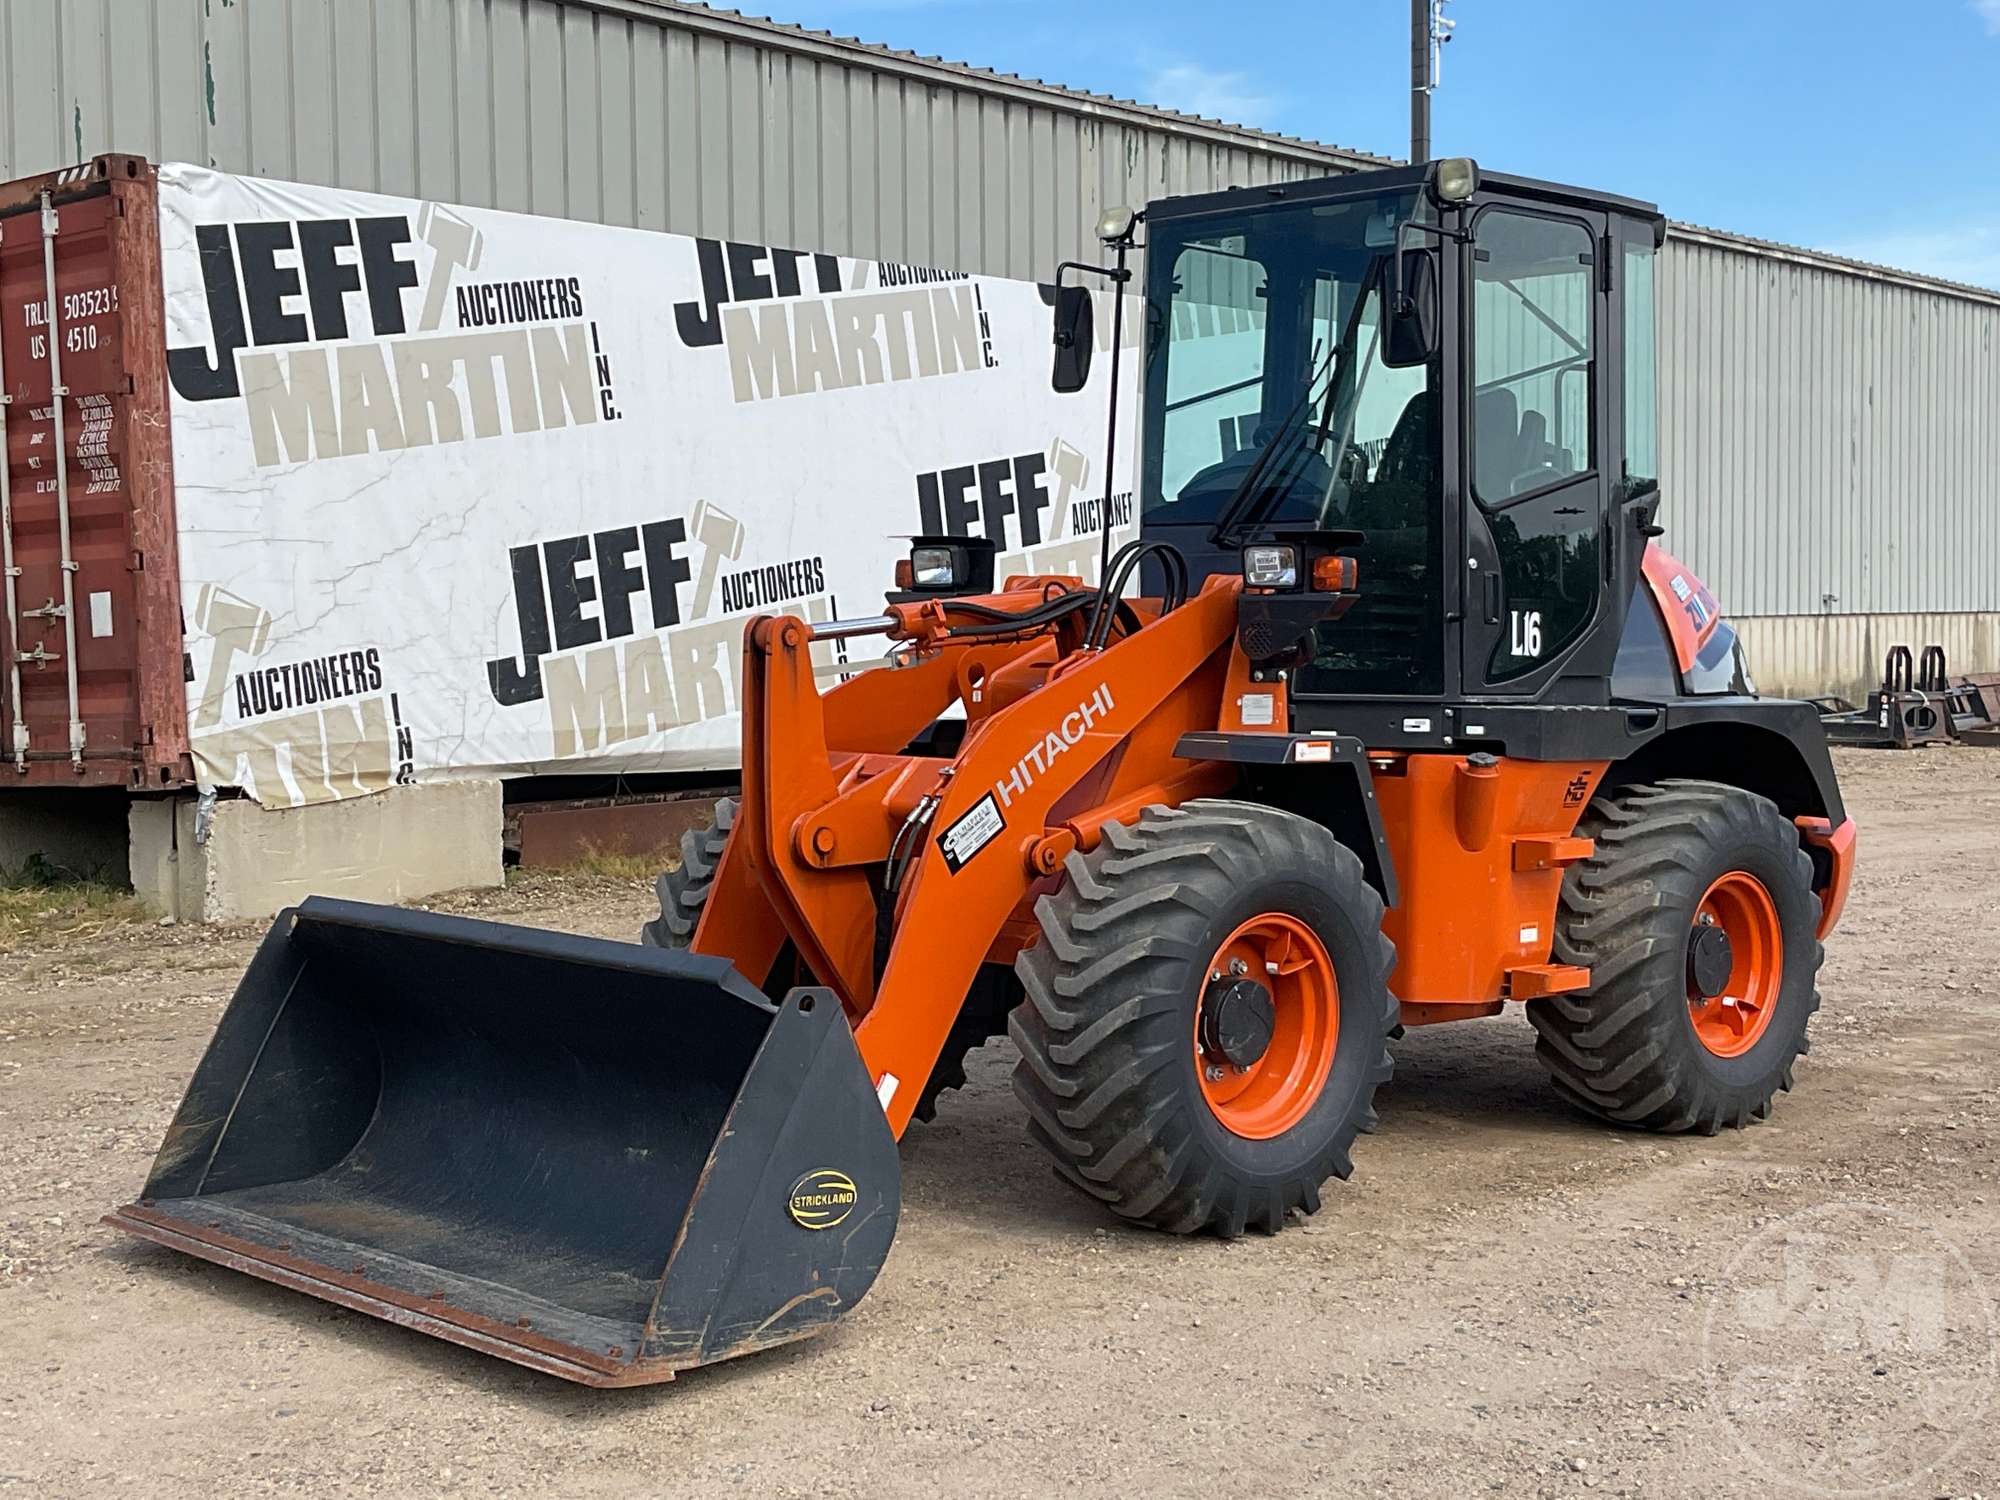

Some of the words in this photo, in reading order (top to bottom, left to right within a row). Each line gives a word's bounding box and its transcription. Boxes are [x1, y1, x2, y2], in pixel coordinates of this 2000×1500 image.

[167, 216, 419, 402] JEFF
[456, 277, 583, 328] AUCTIONEERS
[878, 262, 969, 287] AUCTIO
[31, 335, 46, 360] US
[67, 325, 97, 353] 4510
[723, 285, 981, 403] MARTIN
[974, 284, 998, 368] INC.
[239, 324, 598, 467] MARTIN
[591, 322, 622, 420] INC.
[1072, 491, 1132, 536] AUCTONE
[487, 517, 691, 706] JEFF
[721, 556, 825, 613] AUCTIONEERS
[1510, 610, 1541, 657] L16
[235, 648, 383, 719] AUCTIONEERS
[996, 682, 1115, 808] HITACHI
[794, 1192, 853, 1208] STRICKLAND
